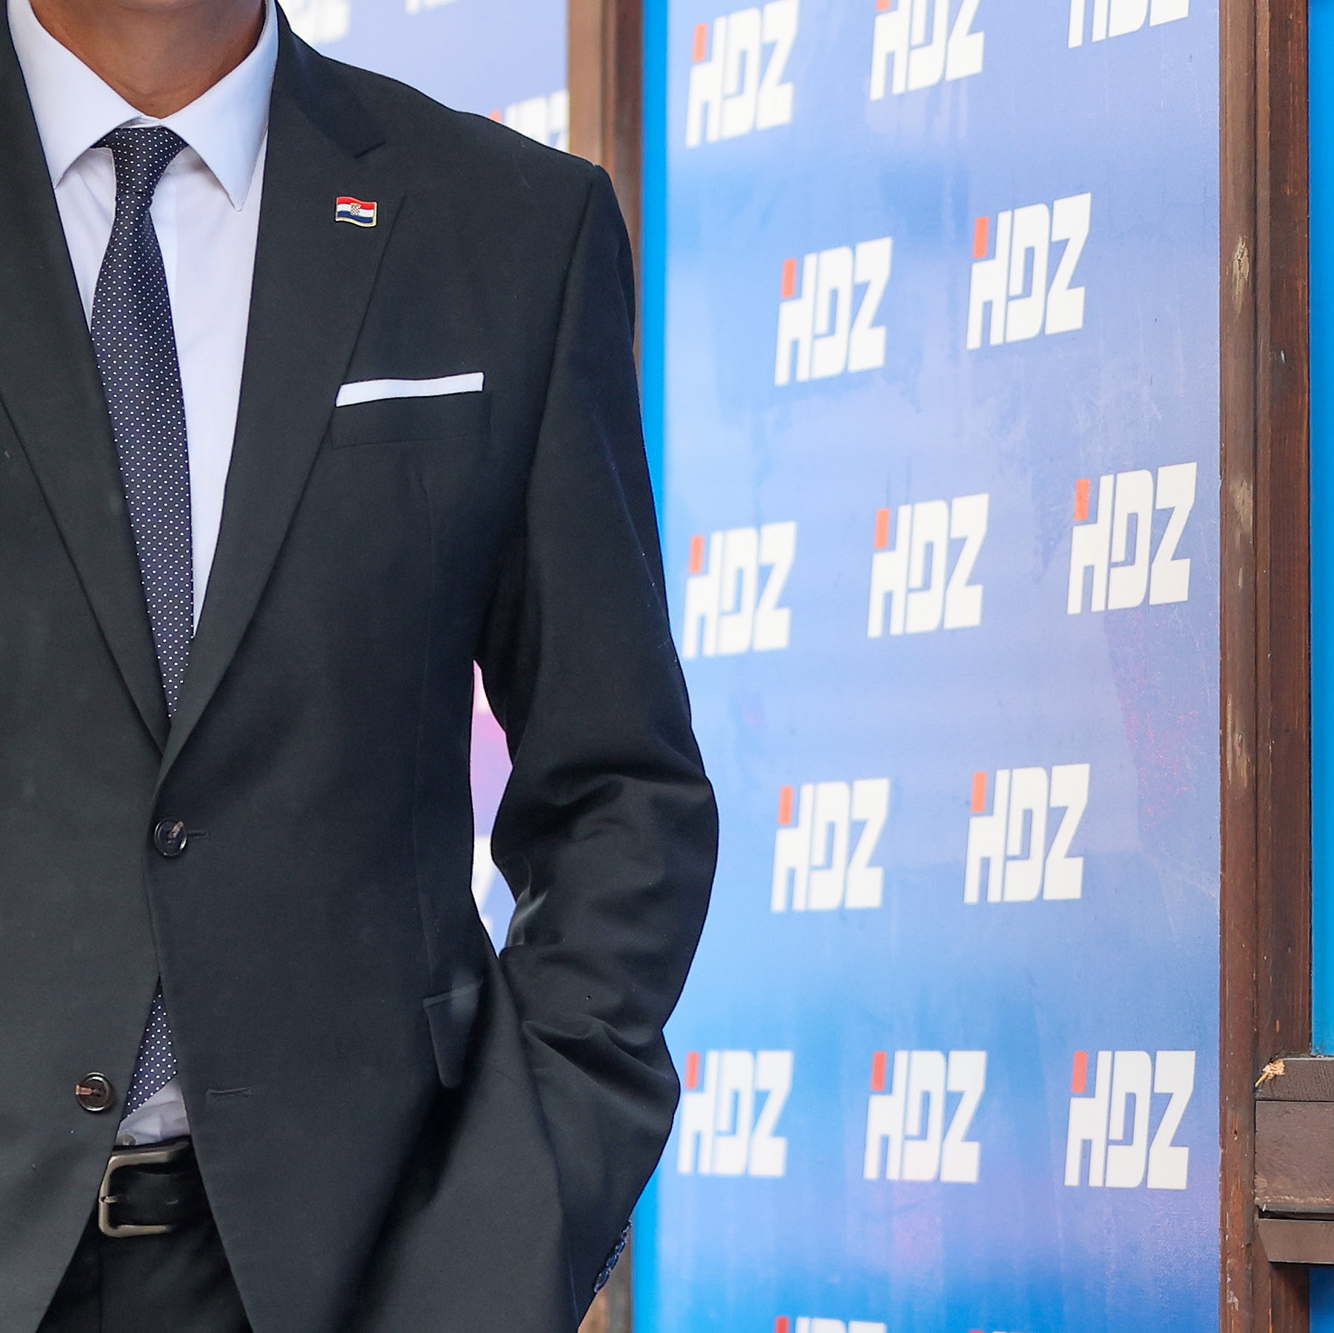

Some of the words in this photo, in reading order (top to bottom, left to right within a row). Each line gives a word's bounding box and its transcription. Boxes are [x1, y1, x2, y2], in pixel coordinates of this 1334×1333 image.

[775, 237, 892, 385] HDZ
[966, 193, 1091, 350] HDZ
[683, 521, 797, 659] HDZ
[868, 493, 989, 637] HDZ
[1067, 462, 1197, 614] HDZ
[772, 778, 890, 911] HDZ
[965, 763, 1090, 903] HDZ
[677, 1051, 793, 1177] HDZ
[864, 1051, 986, 1183] HDZ
[1065, 1051, 1195, 1189] HDZ
